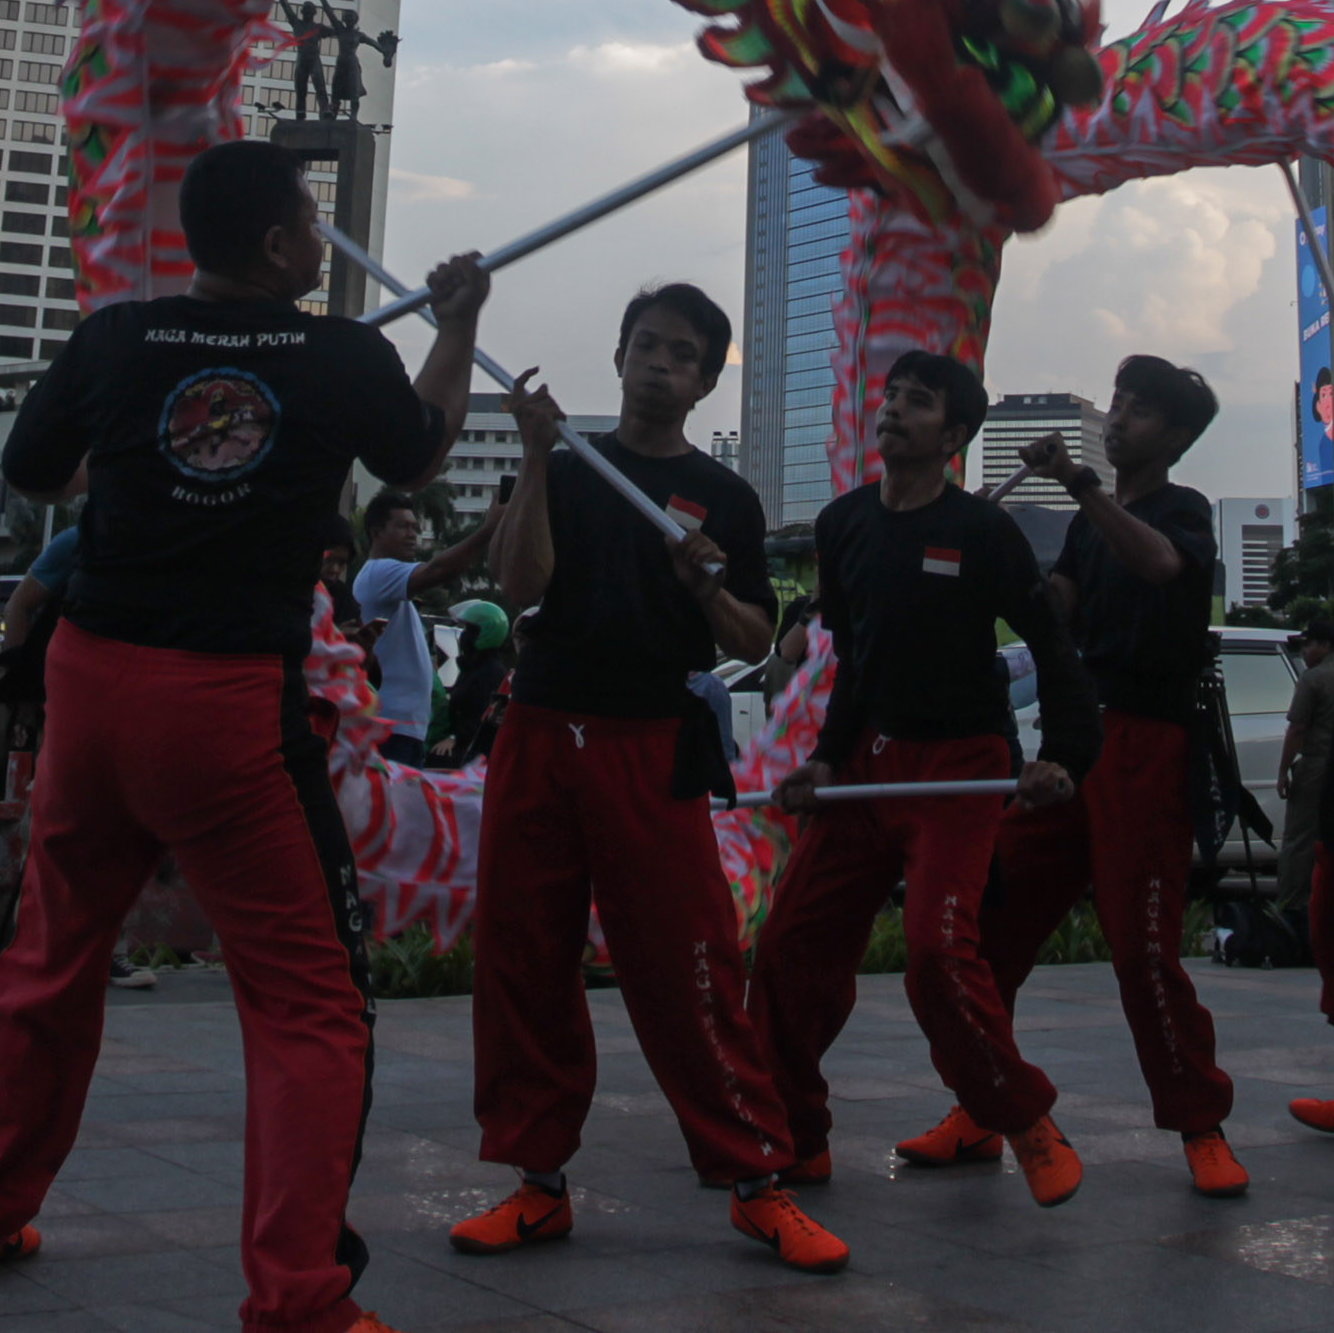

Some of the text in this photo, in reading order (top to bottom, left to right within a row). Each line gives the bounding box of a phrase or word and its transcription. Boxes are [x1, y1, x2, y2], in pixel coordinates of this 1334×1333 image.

[144, 328, 306, 347] NAGA MERAH PUTIH
[171, 483, 252, 506] BOGOR
[1147, 877, 1161, 933] NAGA
